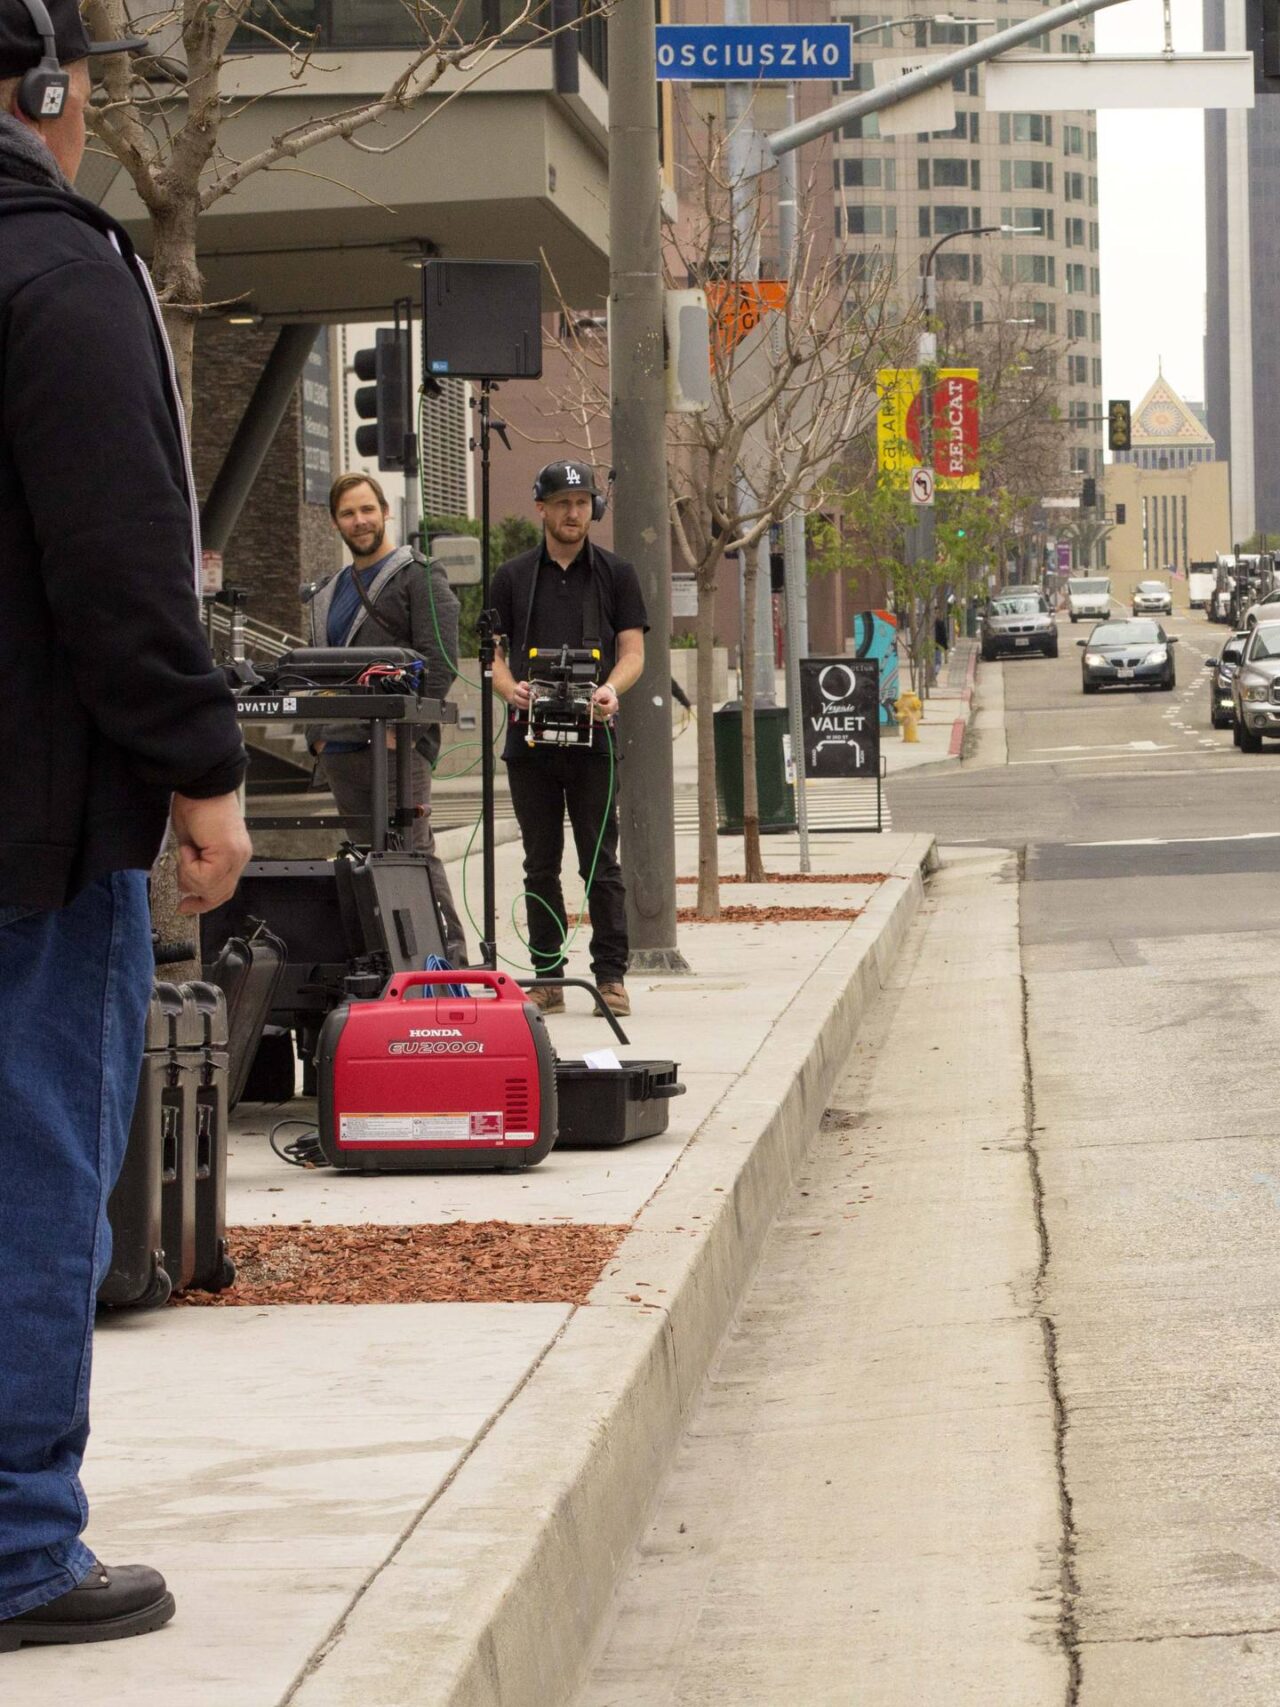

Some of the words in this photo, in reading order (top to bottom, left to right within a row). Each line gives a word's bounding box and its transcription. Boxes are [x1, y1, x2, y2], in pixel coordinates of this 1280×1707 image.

[657, 38, 839, 67] osciuszko
[947, 380, 965, 473] REDCAT
[564, 465, 581, 485] LA
[236, 702, 279, 713] OVATIV
[811, 716, 866, 732] VALET
[409, 1029, 463, 1038] HONDA
